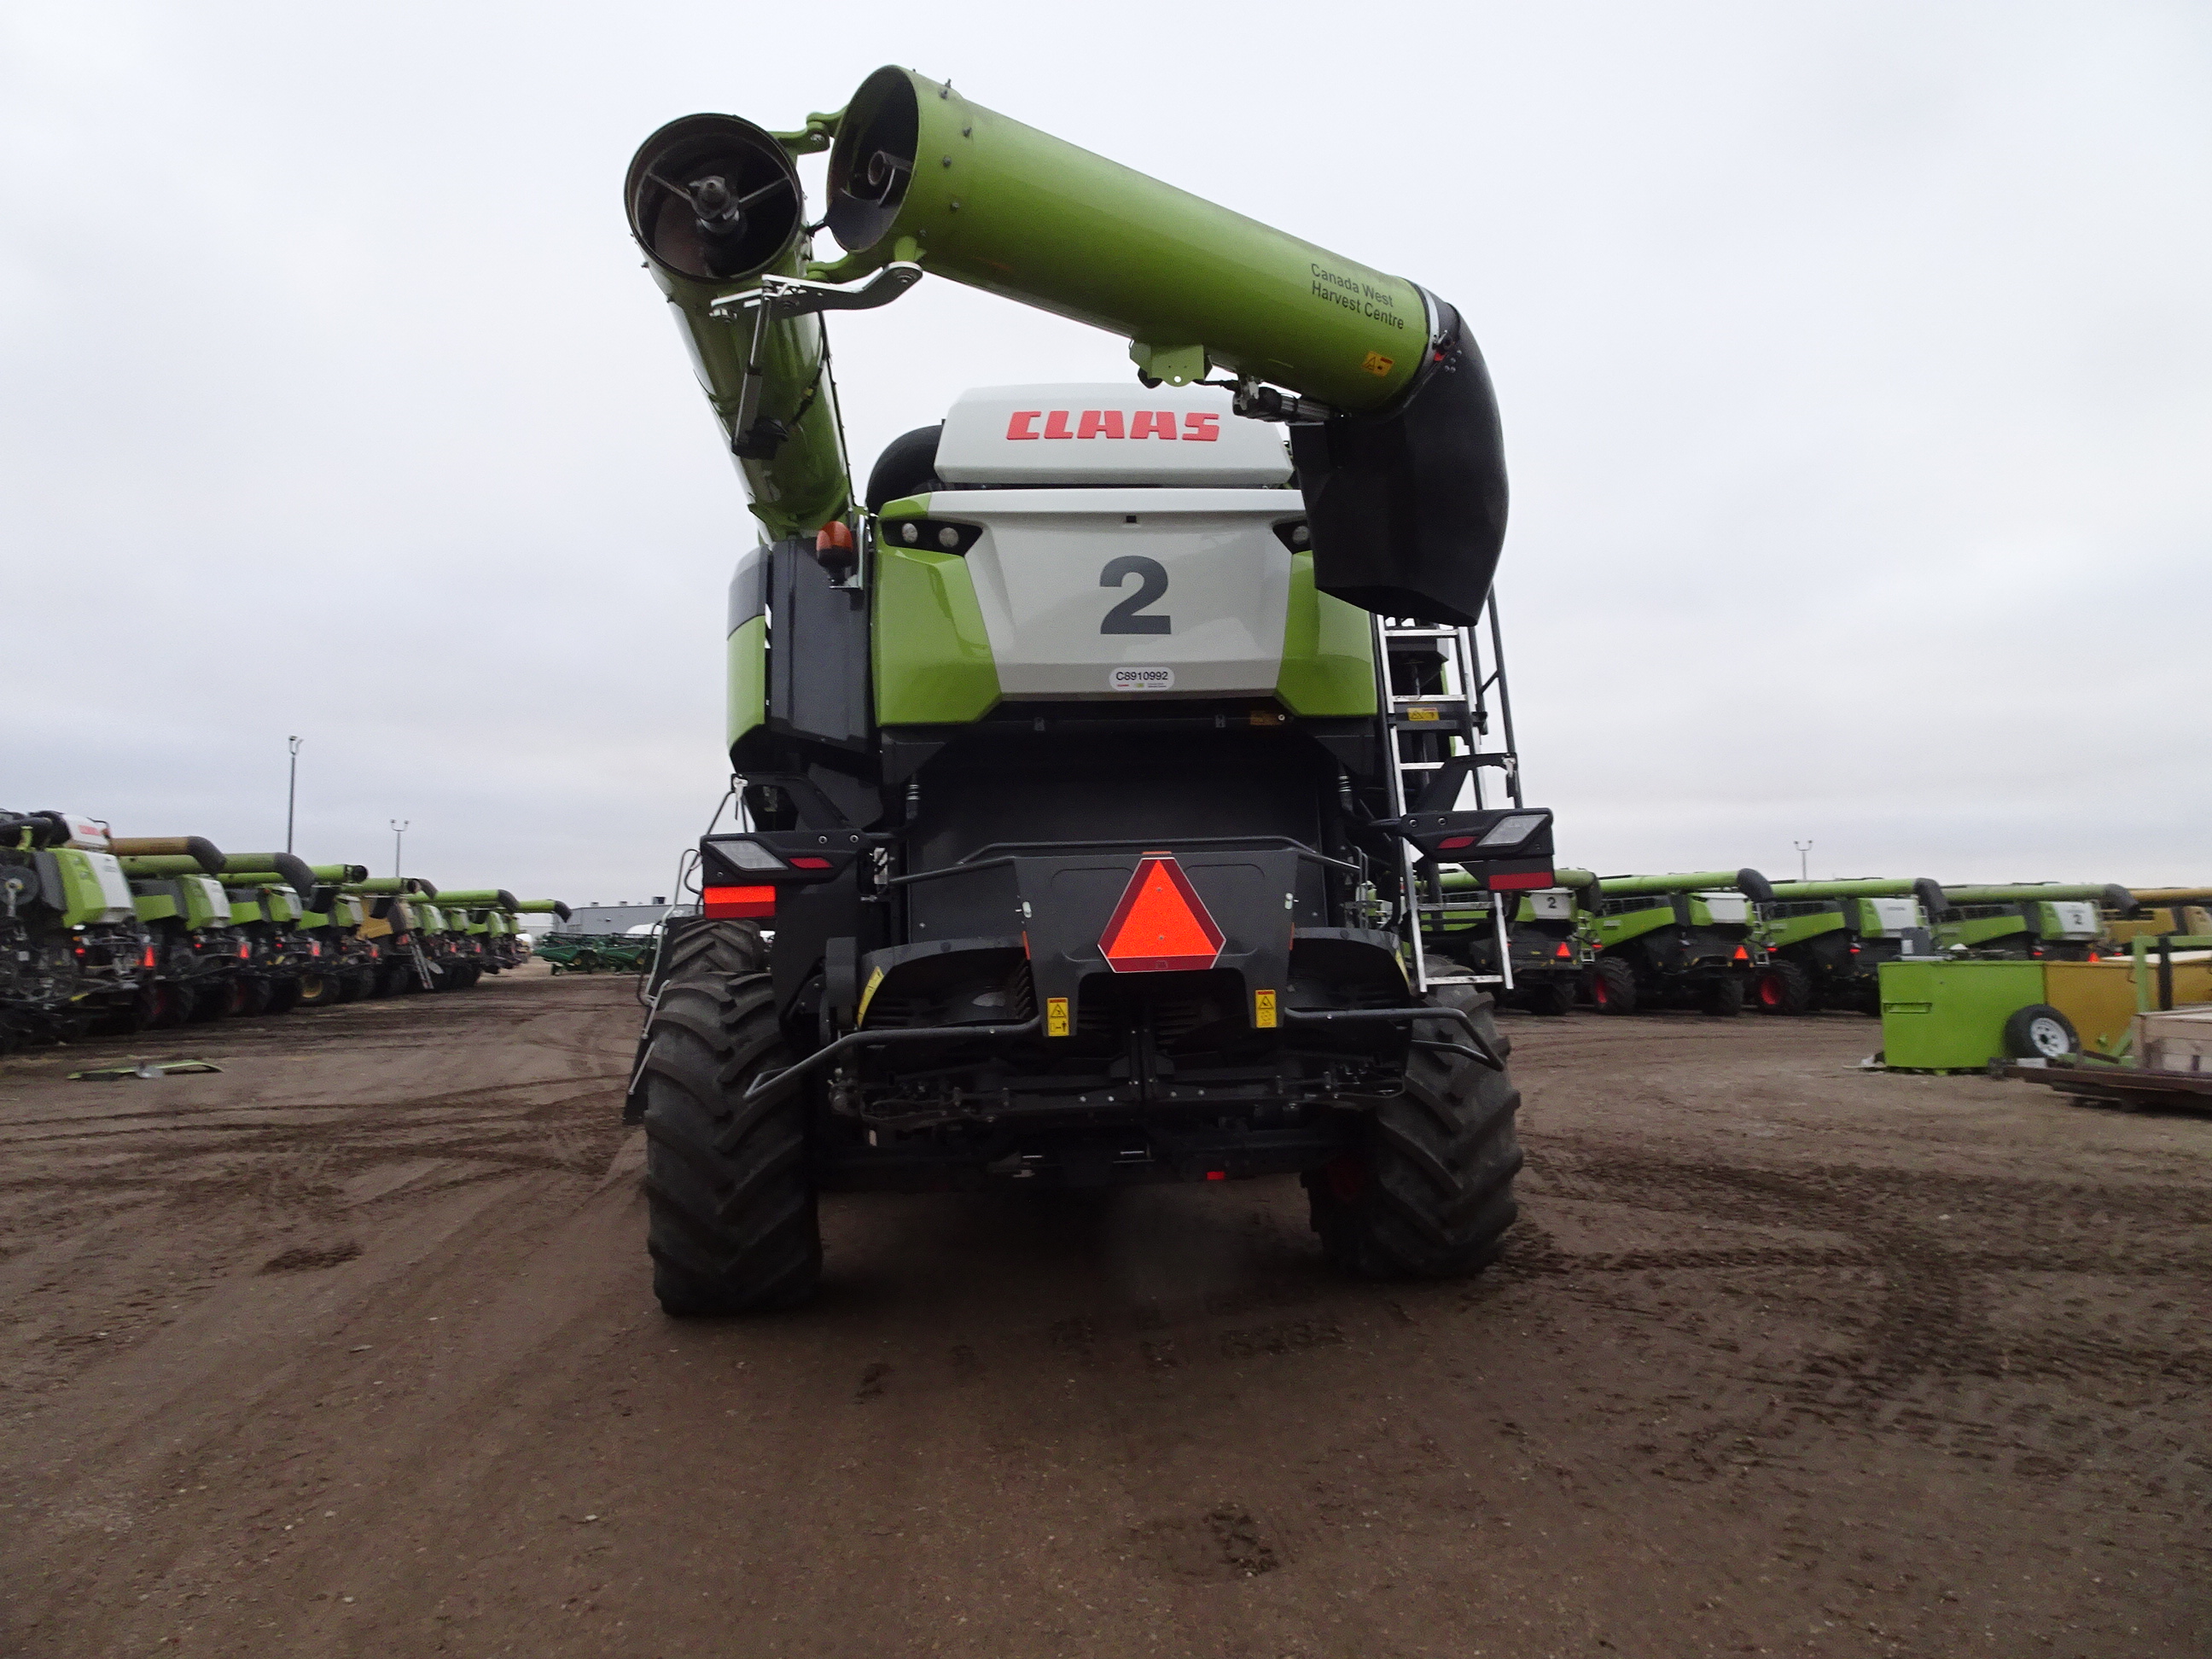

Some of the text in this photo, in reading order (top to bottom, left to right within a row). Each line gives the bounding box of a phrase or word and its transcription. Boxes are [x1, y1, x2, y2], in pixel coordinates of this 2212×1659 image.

[1311, 263, 1394, 307] Canada West
[1312, 280, 1404, 329] Harvest Centre
[1006, 410, 1220, 441] CLAAS
[1099, 555, 1172, 635] 2
[1116, 671, 1168, 681] C8910992
[1546, 896, 1557, 909] 2
